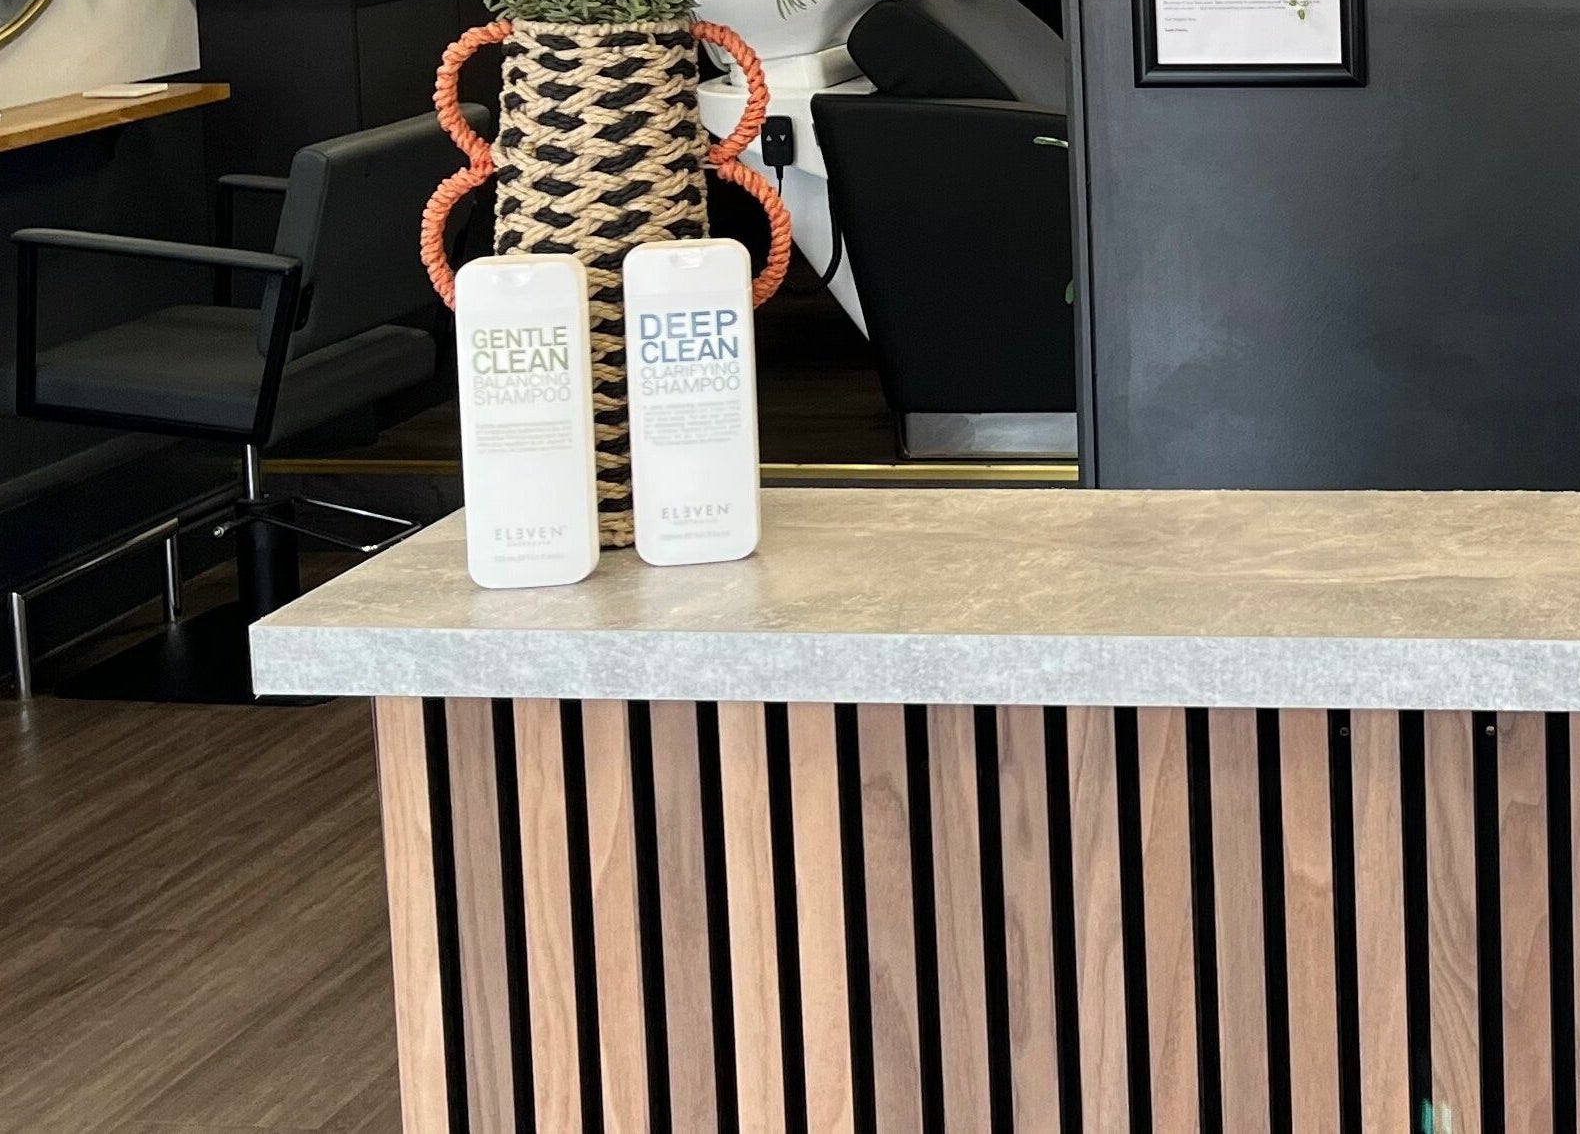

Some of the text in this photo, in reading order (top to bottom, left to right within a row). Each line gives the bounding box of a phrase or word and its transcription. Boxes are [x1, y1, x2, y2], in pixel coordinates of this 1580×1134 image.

[640, 309, 738, 340] DEEP
[472, 326, 568, 349] GENTLE
[472, 347, 569, 374] CLEAN
[641, 336, 739, 364] CLEAN
[473, 372, 571, 389] BALANCING
[640, 361, 740, 380] CLARIFYING
[473, 386, 572, 406] SHAMPOO
[641, 376, 741, 396] SHAMPOO
